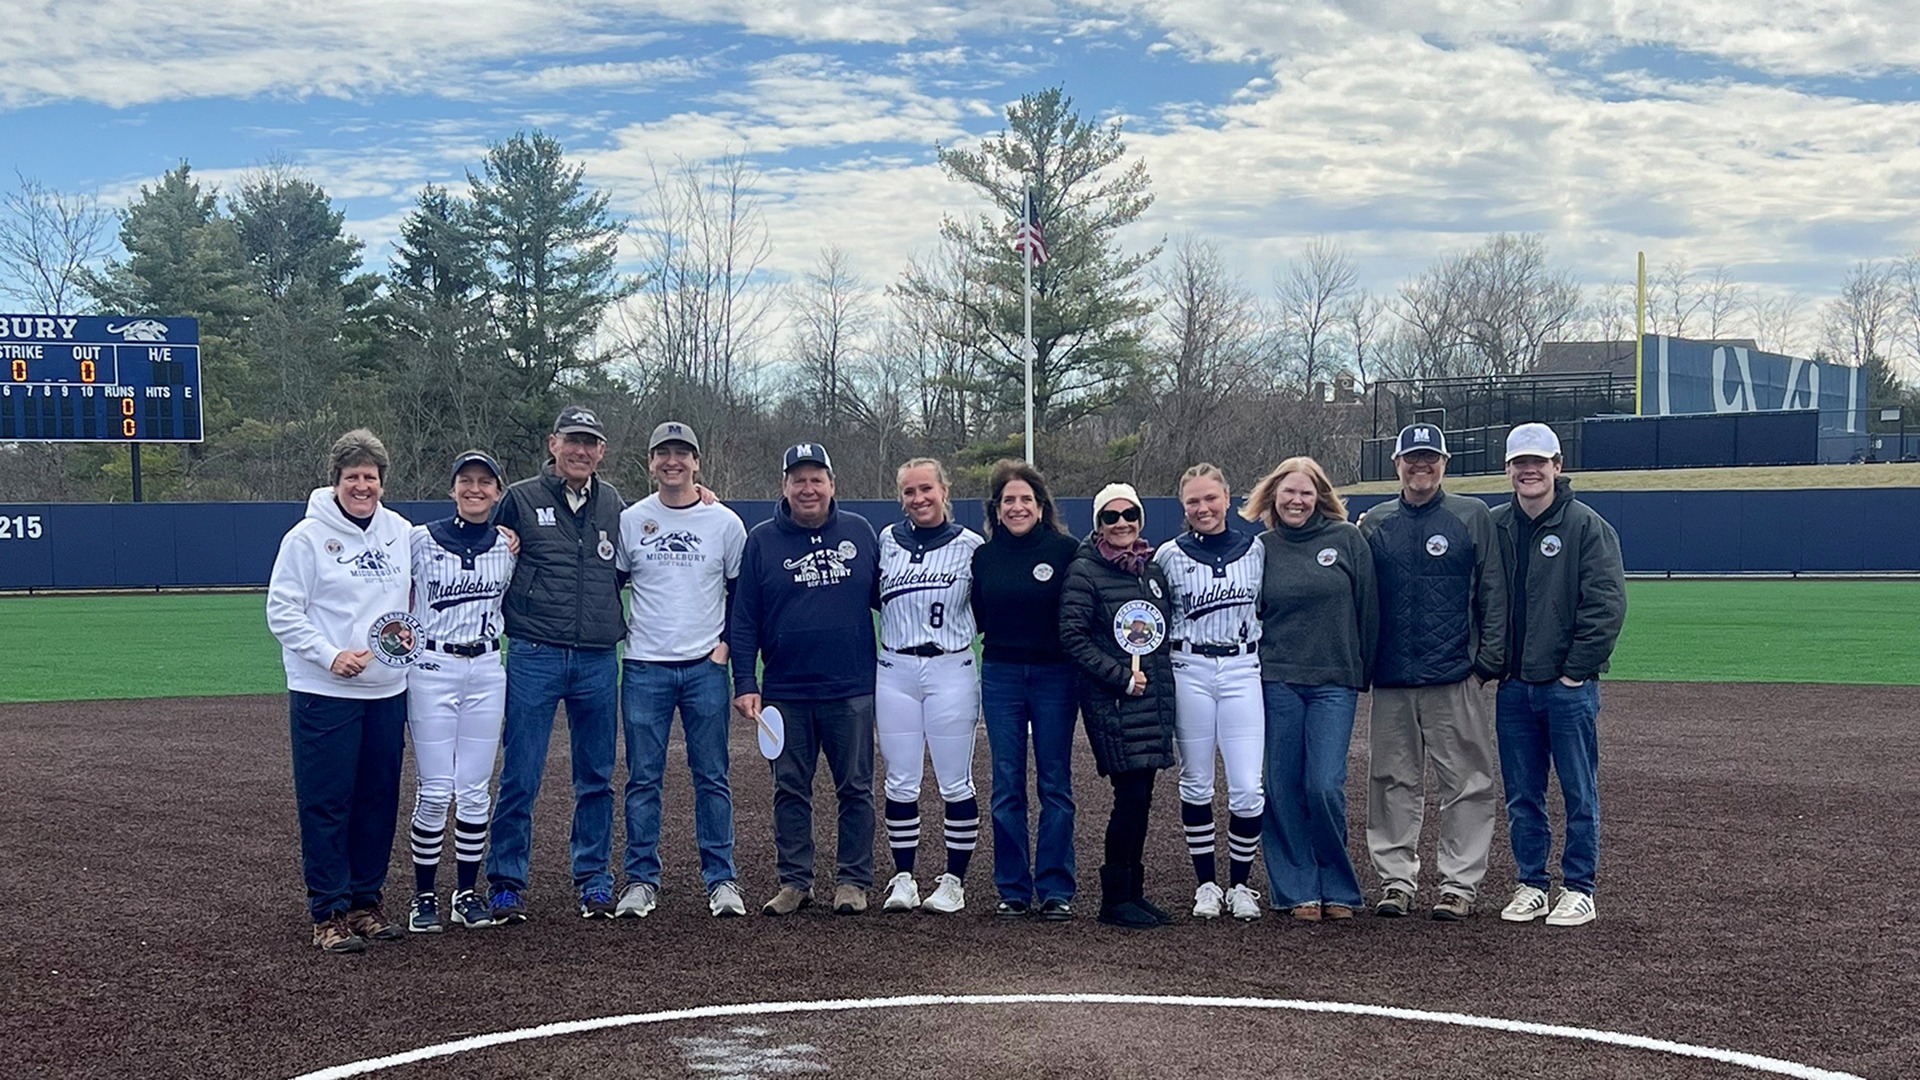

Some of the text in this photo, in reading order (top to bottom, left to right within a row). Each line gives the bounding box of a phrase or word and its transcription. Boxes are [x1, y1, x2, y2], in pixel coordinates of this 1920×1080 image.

[73, 346, 101, 360] OUT
[148, 347, 172, 362] H/E
[12, 360, 26, 381] 0
[81, 360, 95, 382] 0
[3, 385, 192, 398] 6 7 8 9 10 RUNS HITS E
[122, 398, 134, 415] 0
[668, 425, 682, 434] M
[1414, 428, 1430, 440] M
[796, 444, 813, 457] M
[536, 507, 556, 522] M
[0, 516, 42, 539] 215
[646, 553, 706, 562] MIDDLEBURY
[427, 576, 503, 602] Middlebur
[930, 602, 944, 629] 8
[1239, 621, 1248, 643] 4
